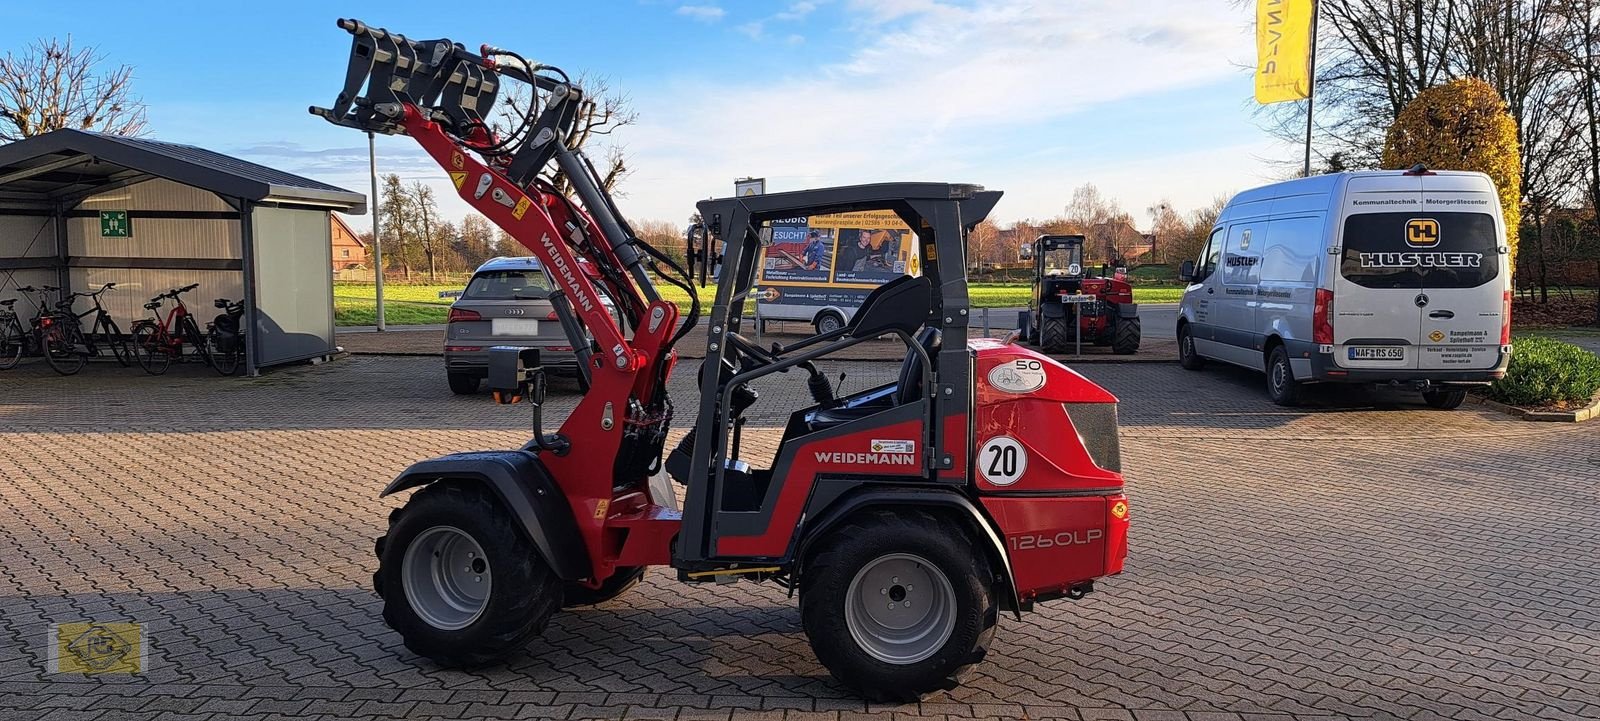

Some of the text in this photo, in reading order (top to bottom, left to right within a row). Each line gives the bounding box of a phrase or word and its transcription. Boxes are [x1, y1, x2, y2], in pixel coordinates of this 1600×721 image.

[1425, 198, 1488, 206] Motorgerätecenter
[773, 231, 807, 240] ESUCHT!
[1359, 252, 1482, 268] HUSTLER
[540, 232, 593, 312] WEIDEMANN
[1070, 265, 1079, 274] 20
[1355, 348, 1403, 358] WAF RS 650
[1016, 360, 1041, 371] 50
[814, 452, 915, 465] WEIDEMANN
[988, 445, 1017, 477] 20
[1010, 528, 1103, 551] 1260LP
